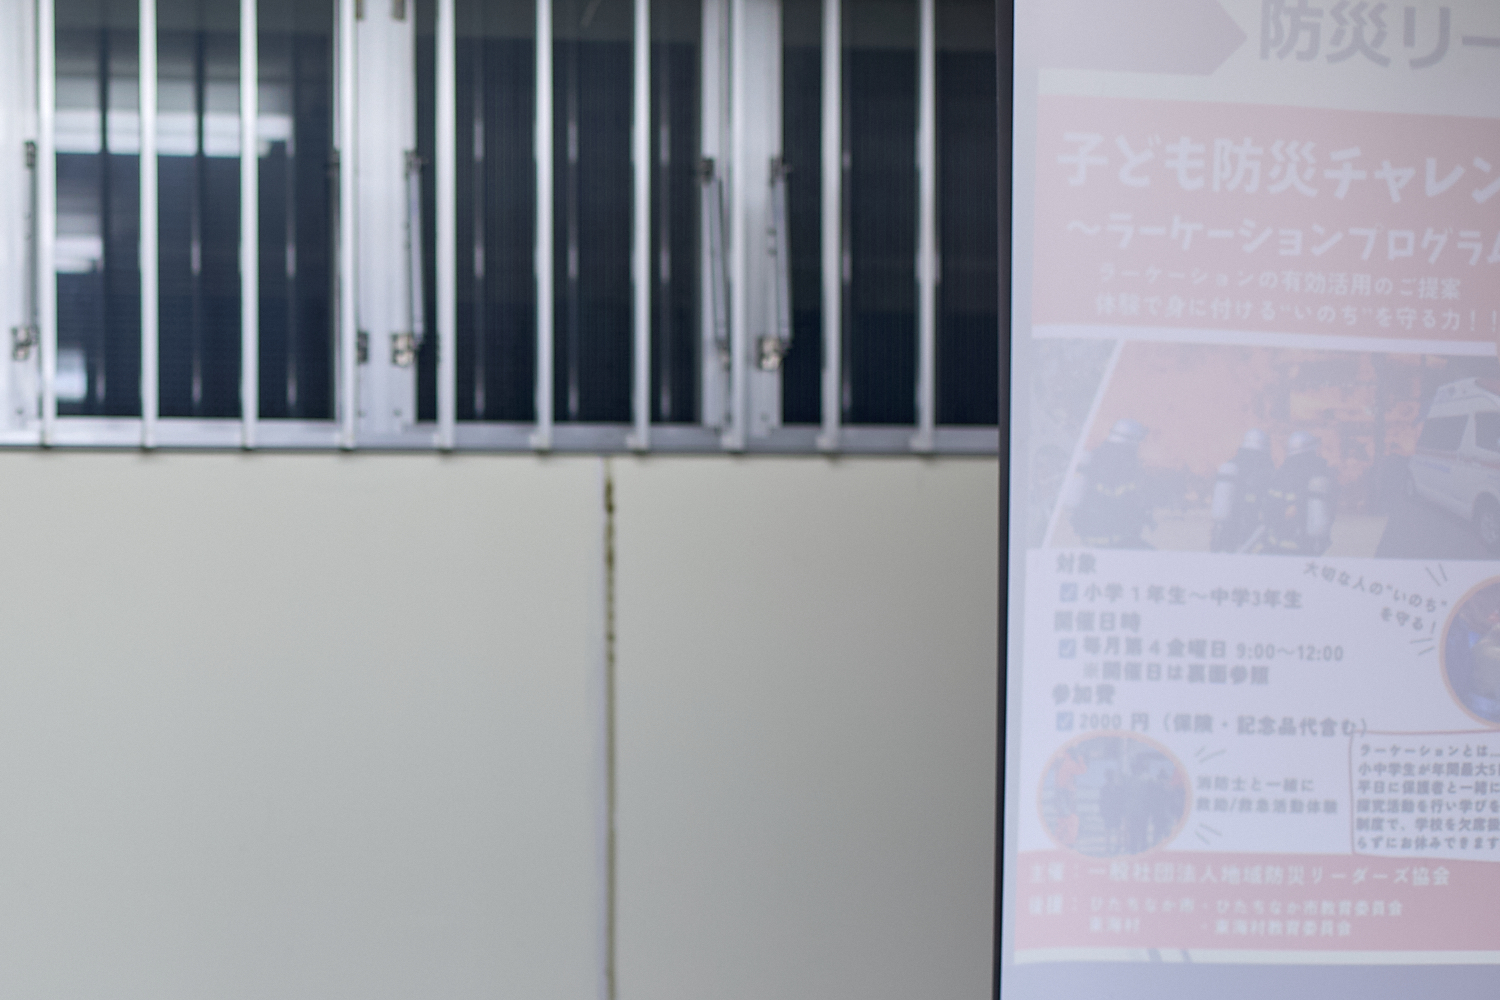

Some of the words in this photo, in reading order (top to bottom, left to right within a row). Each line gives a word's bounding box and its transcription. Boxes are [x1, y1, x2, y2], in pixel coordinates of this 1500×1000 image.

[1057, 132, 1500, 203] 子ども防災チャレン
[1101, 264, 1461, 300] ラーケーションの有効活用のご提案
[1054, 611, 1142, 633] 開催日時
[1052, 684, 1116, 705] 参加費
[1358, 762, 1500, 777] 小中学生が年間最大5
